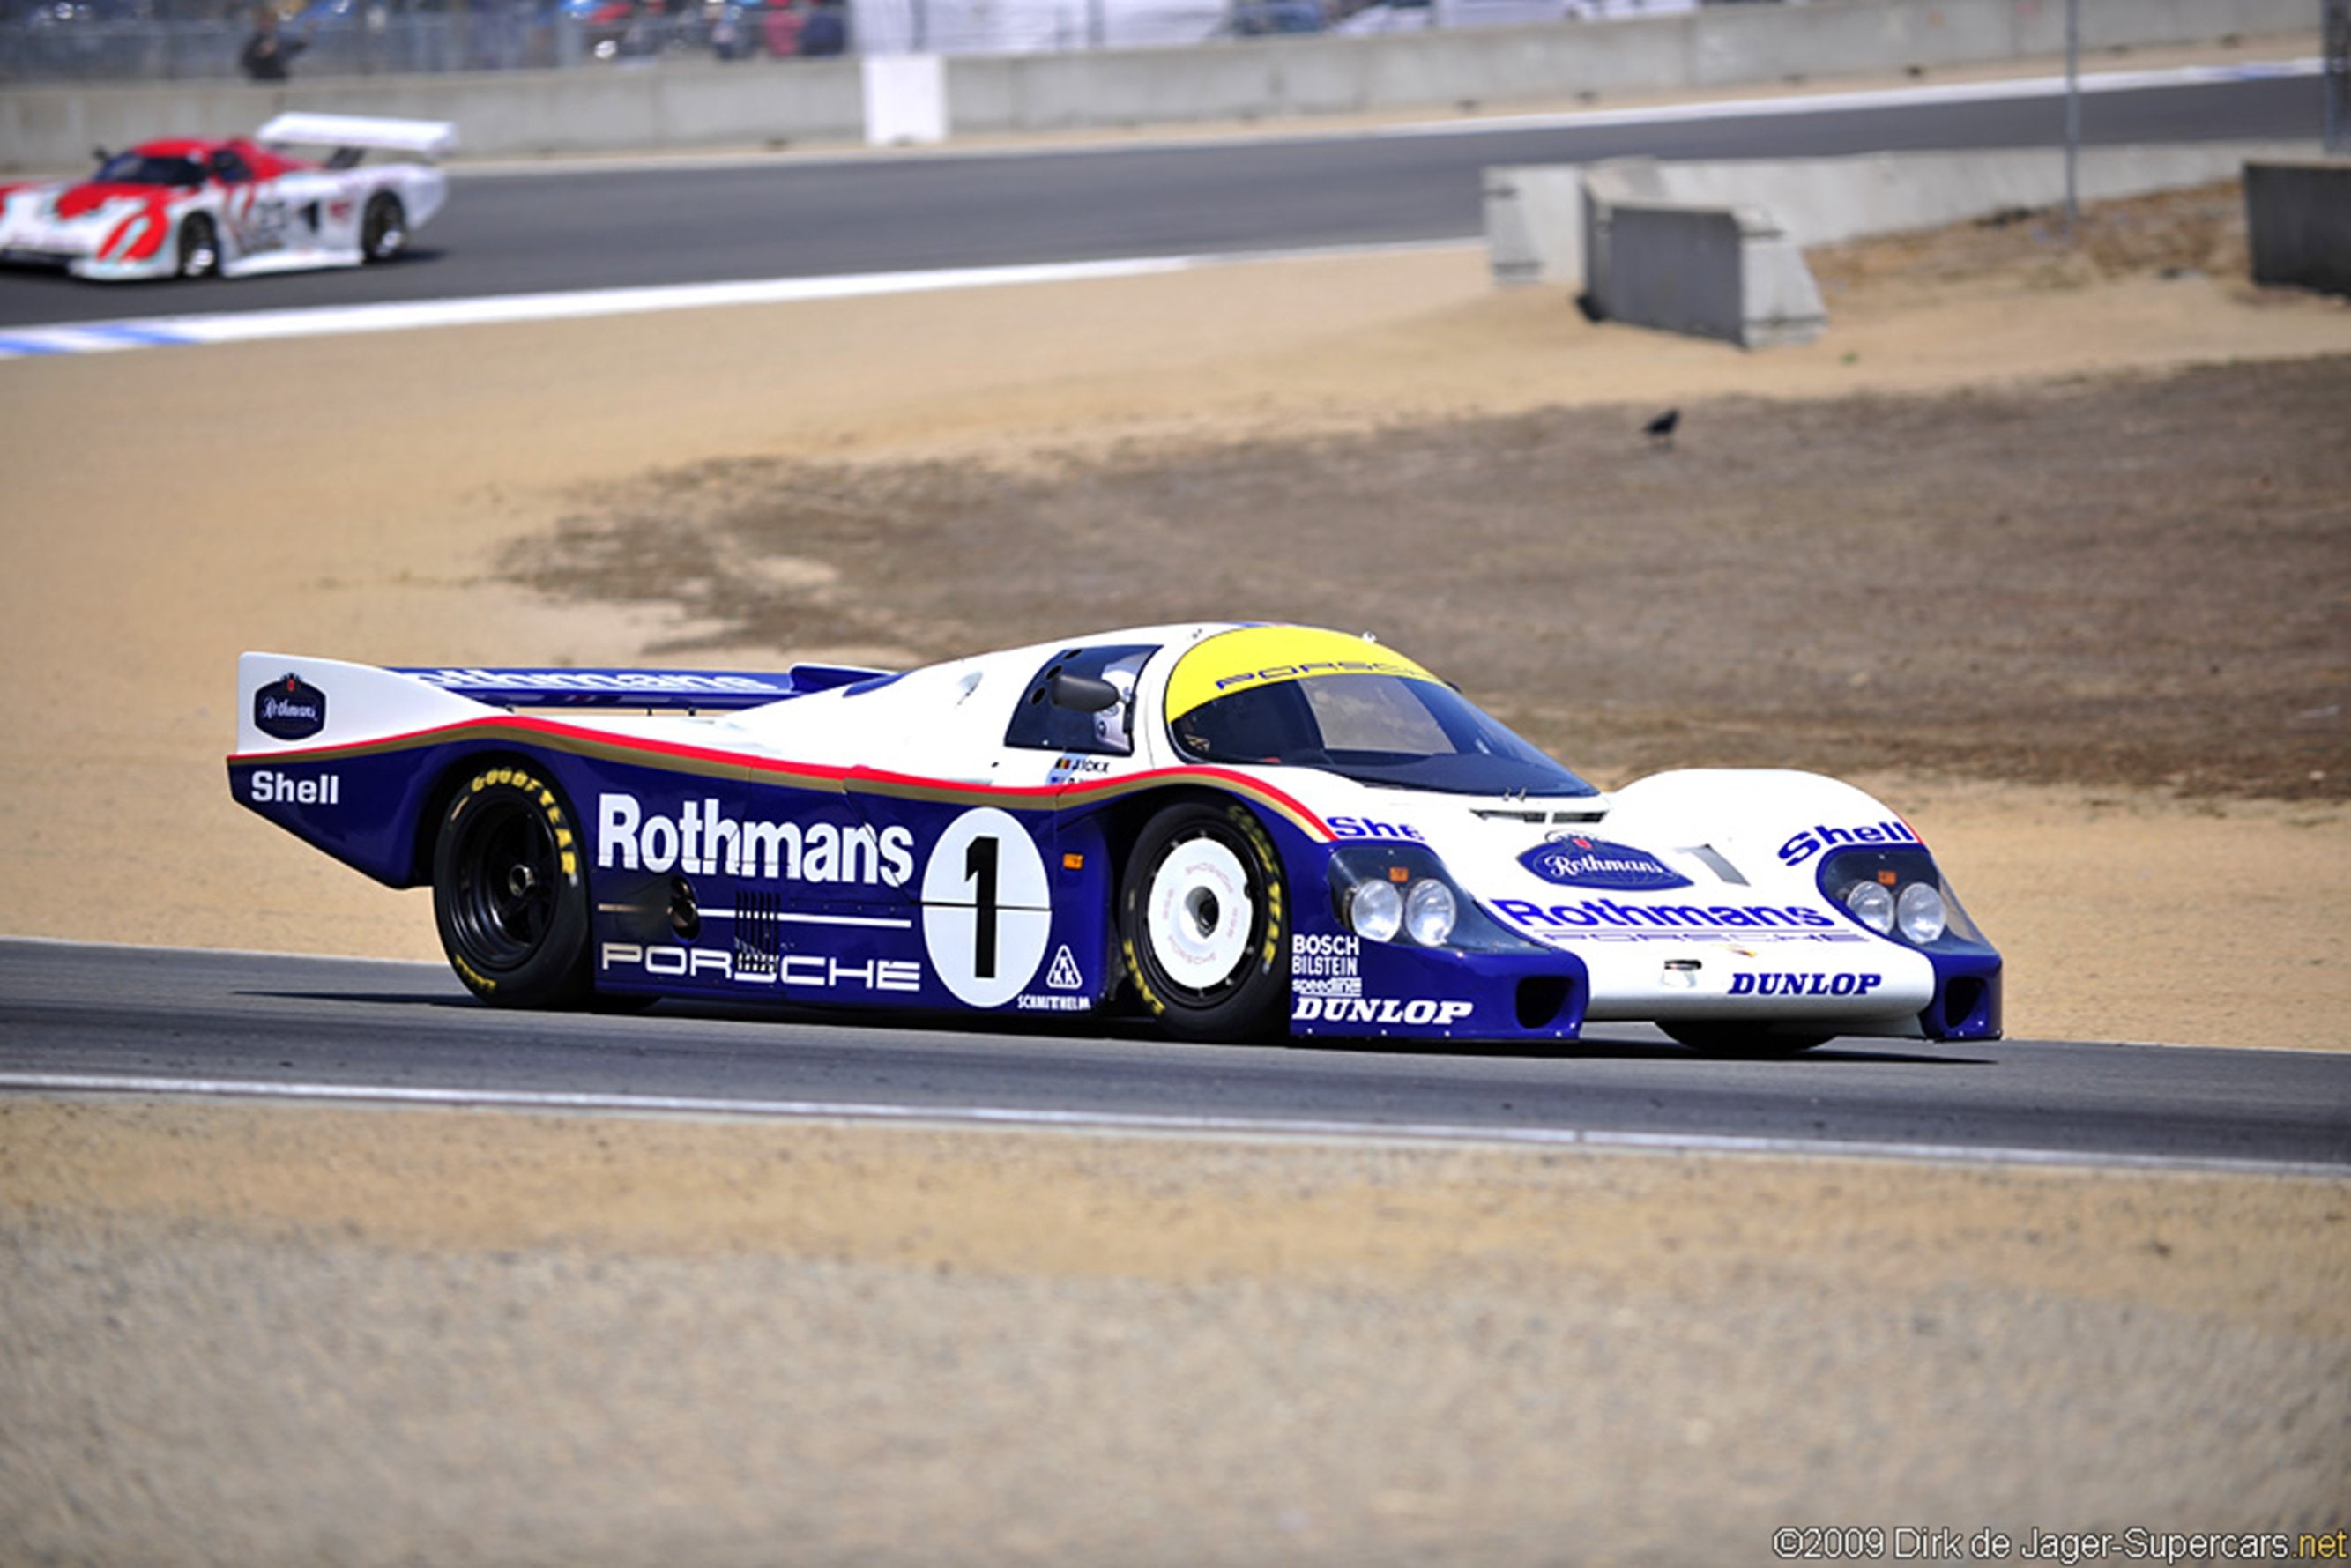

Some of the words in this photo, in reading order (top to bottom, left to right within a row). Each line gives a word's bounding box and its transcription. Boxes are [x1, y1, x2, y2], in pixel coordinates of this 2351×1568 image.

[399, 669, 777, 694] othmans
[251, 770, 339, 805] Shell
[598, 793, 914, 888] Rothmans
[1326, 816, 1426, 841] She
[1777, 821, 1916, 867] Shell
[1544, 854, 1664, 878] Rothmans
[965, 836, 999, 979] 1
[1489, 898, 1835, 927] Rothmans
[1292, 934, 1360, 956] BOSCH
[602, 942, 921, 992] PORSCHE
[1292, 955, 1358, 977] BILSTEIN
[1727, 973, 1882, 996] DUNLOP
[1291, 997, 1474, 1025] DUNLOP
